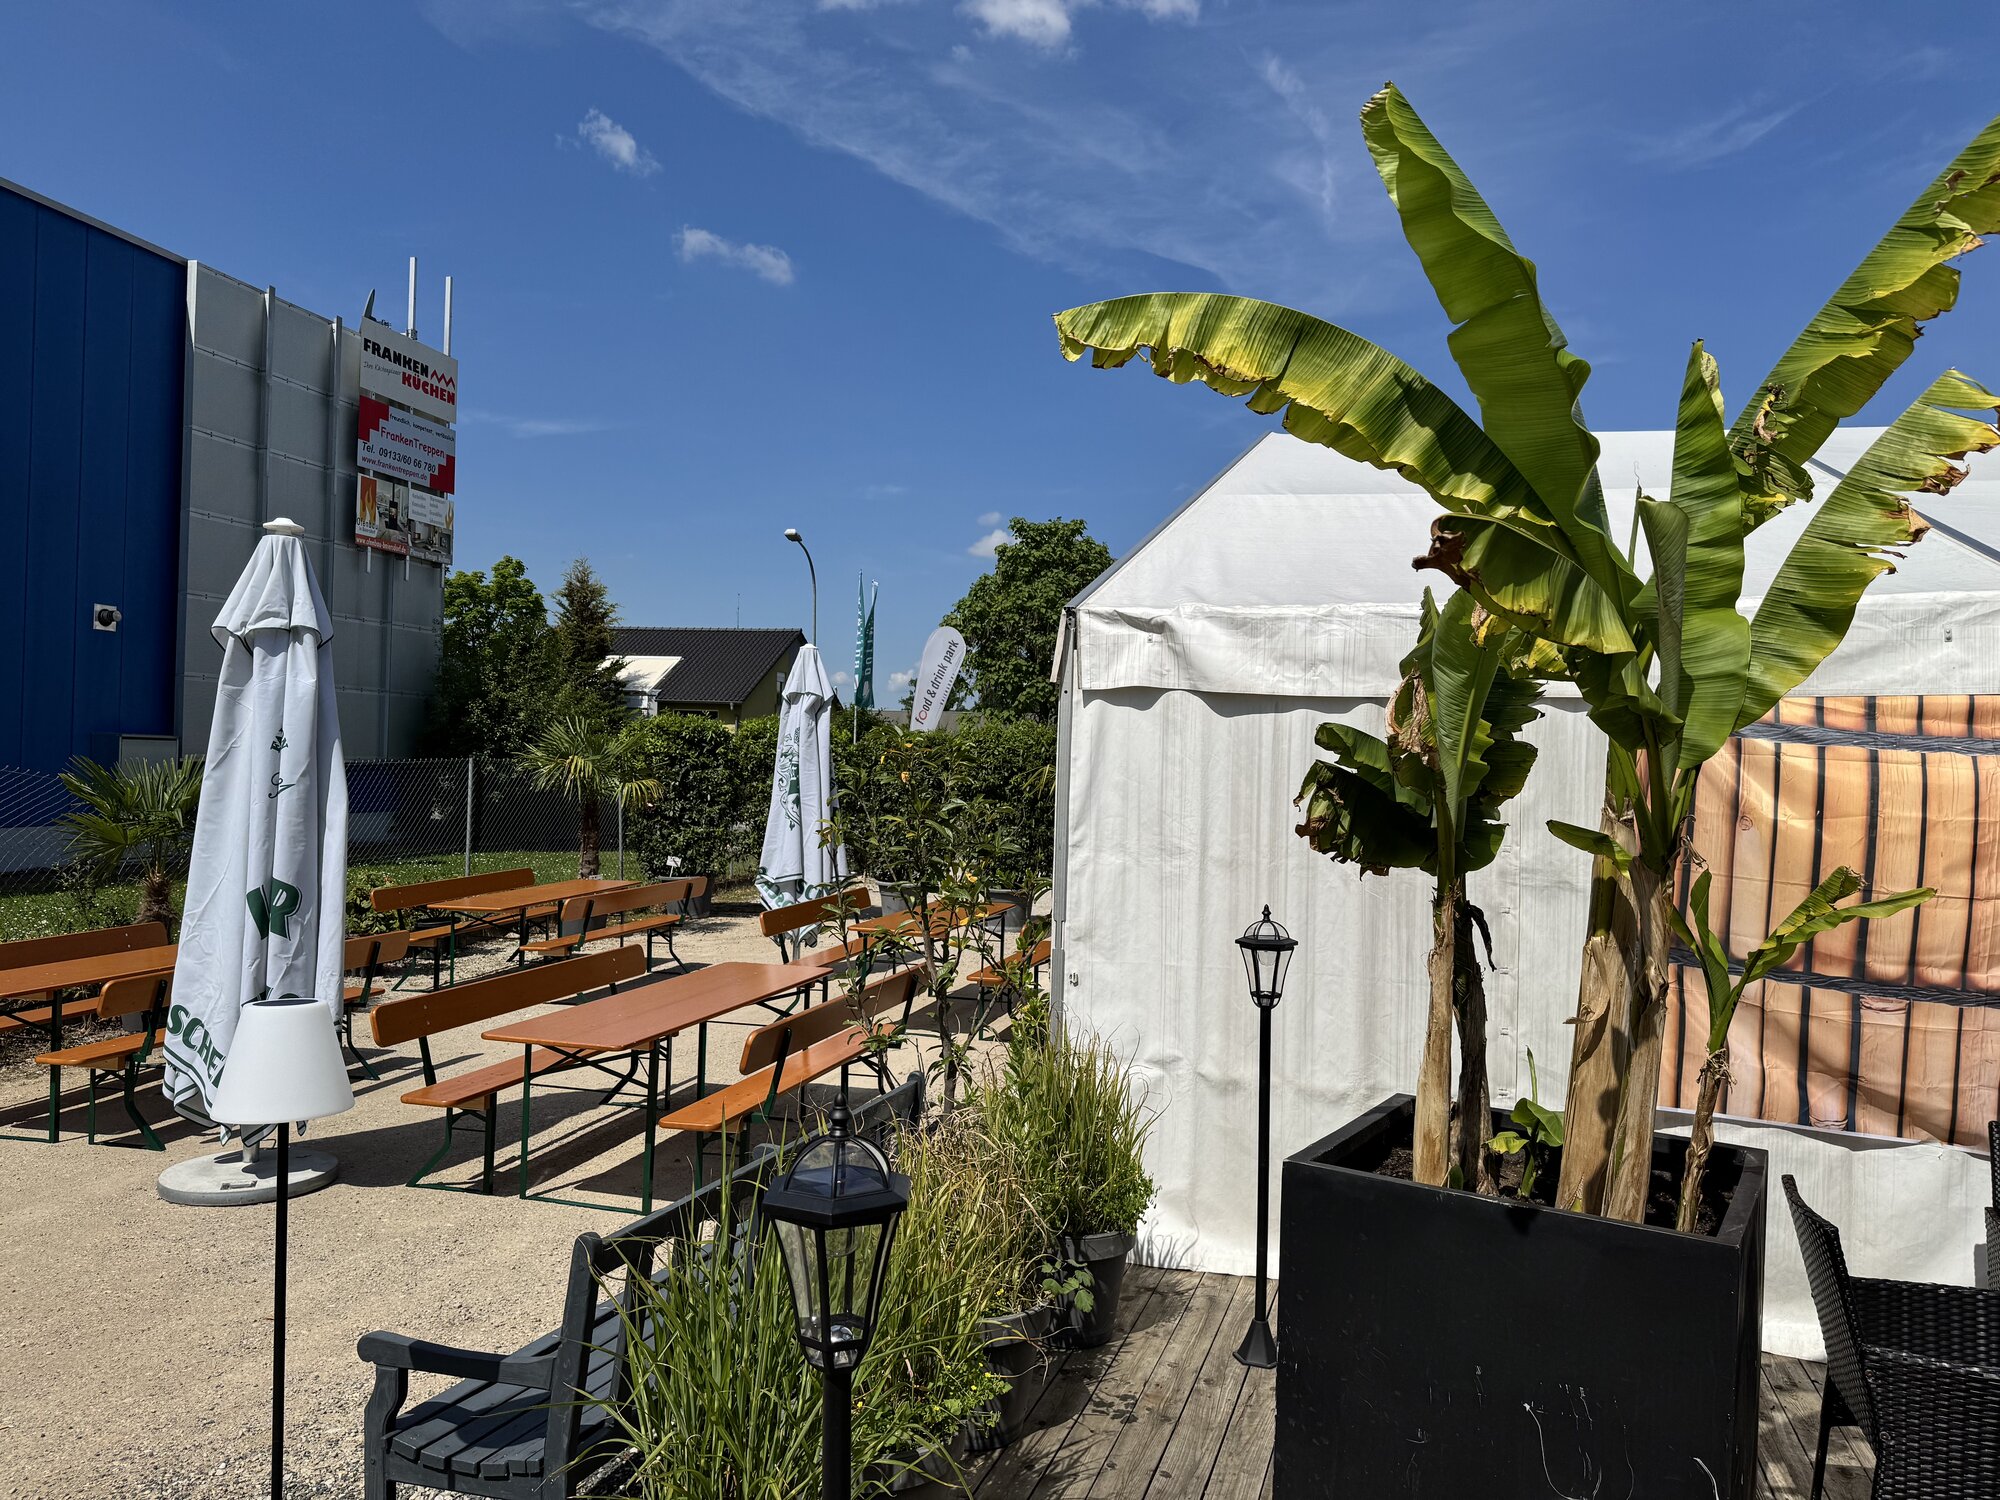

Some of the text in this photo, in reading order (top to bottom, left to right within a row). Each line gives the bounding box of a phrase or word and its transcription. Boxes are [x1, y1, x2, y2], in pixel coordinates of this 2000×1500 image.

[364, 337, 429, 378] FRANKEN
[402, 371, 456, 405] KÜCHEN
[362, 441, 436, 473] Tel. 09133/60 66 780
[380, 426, 445, 458] FrankenTreppen
[361, 455, 427, 480] www.frankentreppen.de
[915, 639, 959, 725] food & drink park
